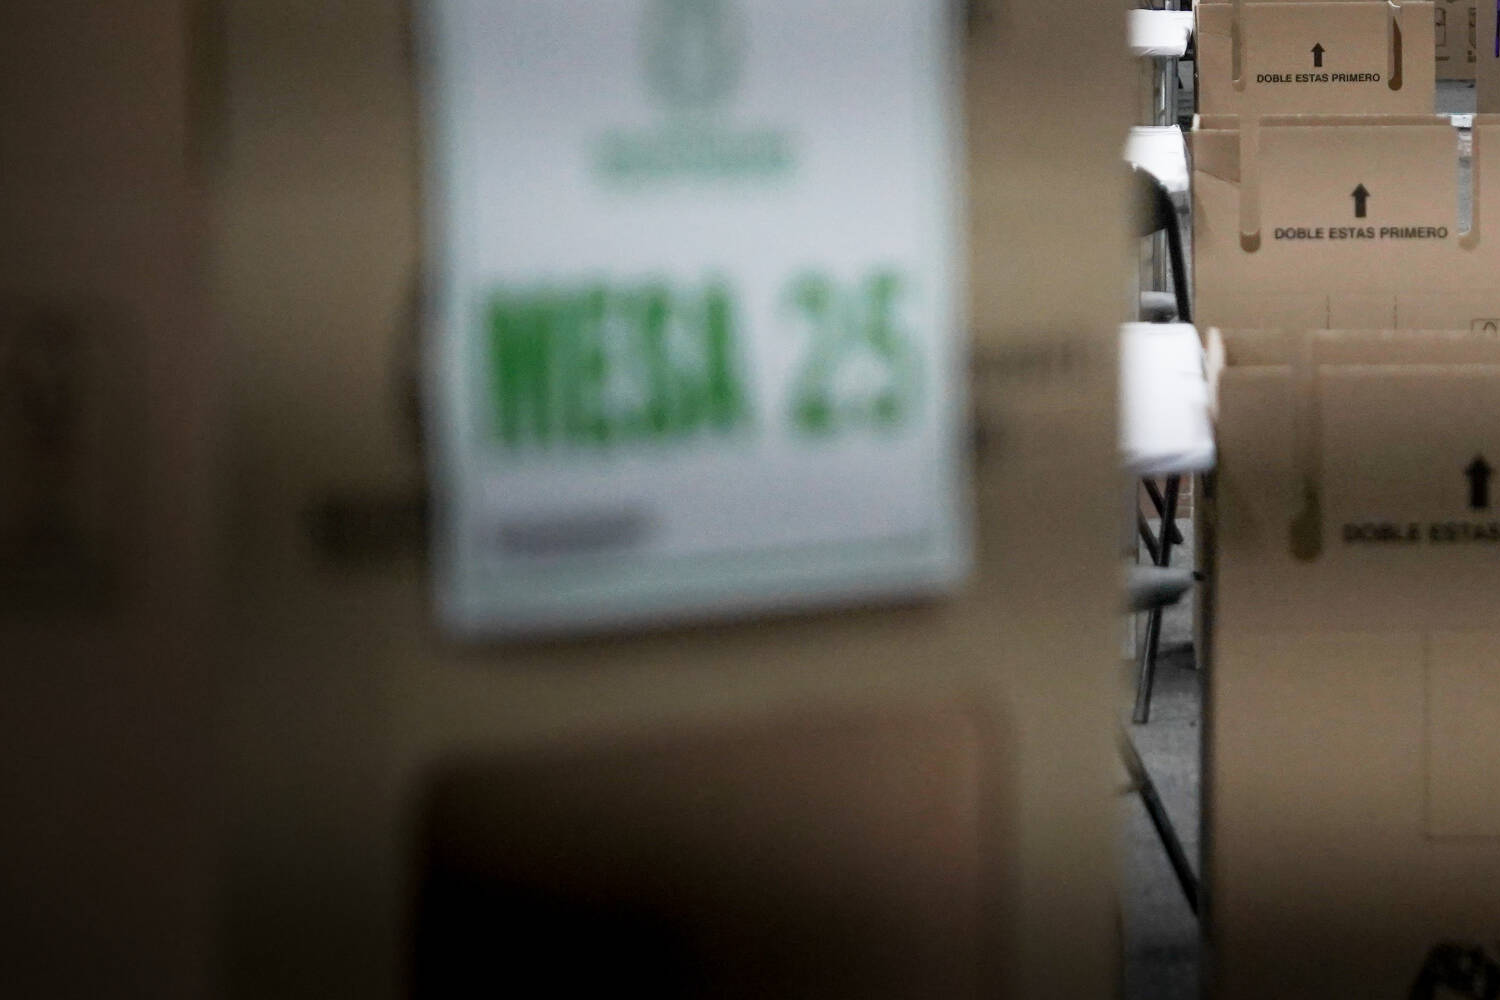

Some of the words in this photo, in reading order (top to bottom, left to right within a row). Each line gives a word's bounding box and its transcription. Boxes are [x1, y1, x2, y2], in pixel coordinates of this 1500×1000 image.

[1256, 73, 1292, 84] DOBLE
[1295, 73, 1329, 83] ESTAS
[1331, 73, 1381, 83] PRIMERO
[1274, 227, 1324, 240] DOBLE
[1328, 226, 1376, 240] ESTAS
[1379, 226, 1449, 239] PRIMERO
[482, 276, 746, 454] MESA
